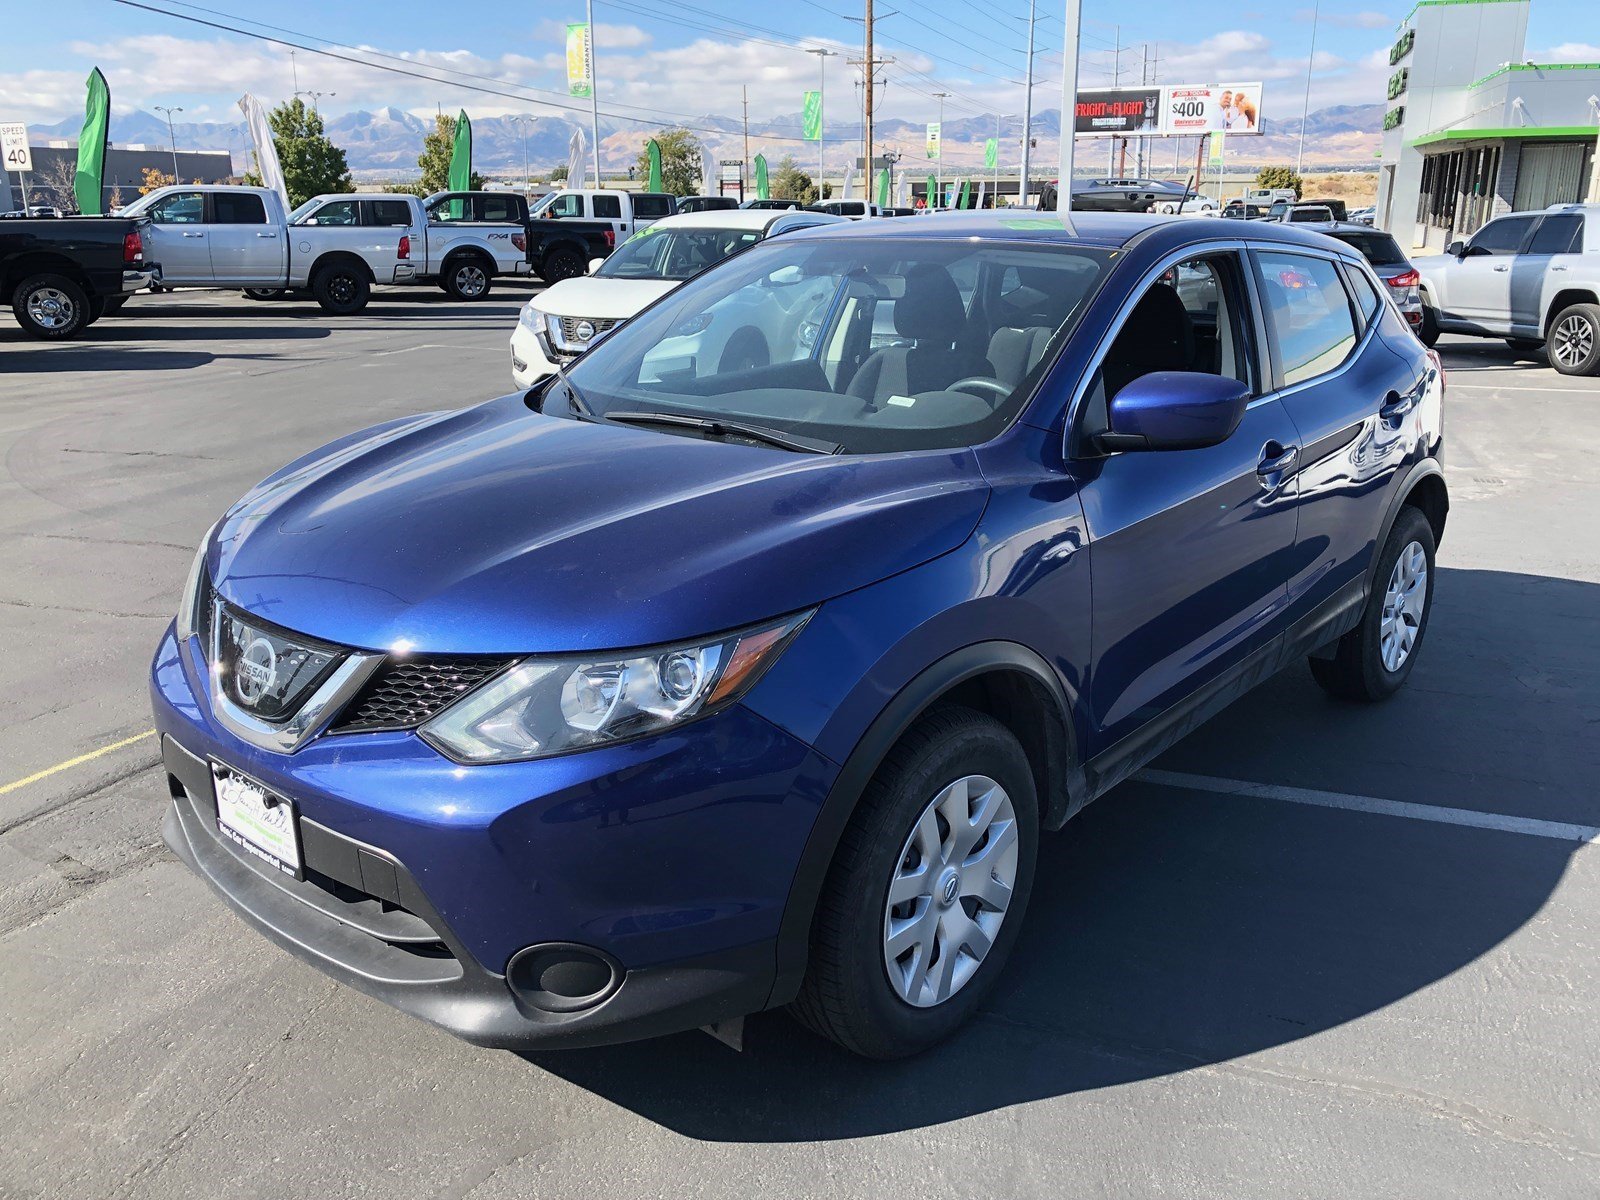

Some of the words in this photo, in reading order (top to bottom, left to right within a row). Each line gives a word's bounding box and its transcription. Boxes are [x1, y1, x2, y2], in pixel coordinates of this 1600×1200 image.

[1076, 102, 1107, 116] FRIGHT
[1113, 102, 1144, 116] FLIGHT
[1172, 102, 1204, 117] $400
[2, 126, 24, 135] SPEED
[8, 149, 26, 164] 40
[240, 660, 270, 682] NISSAN
